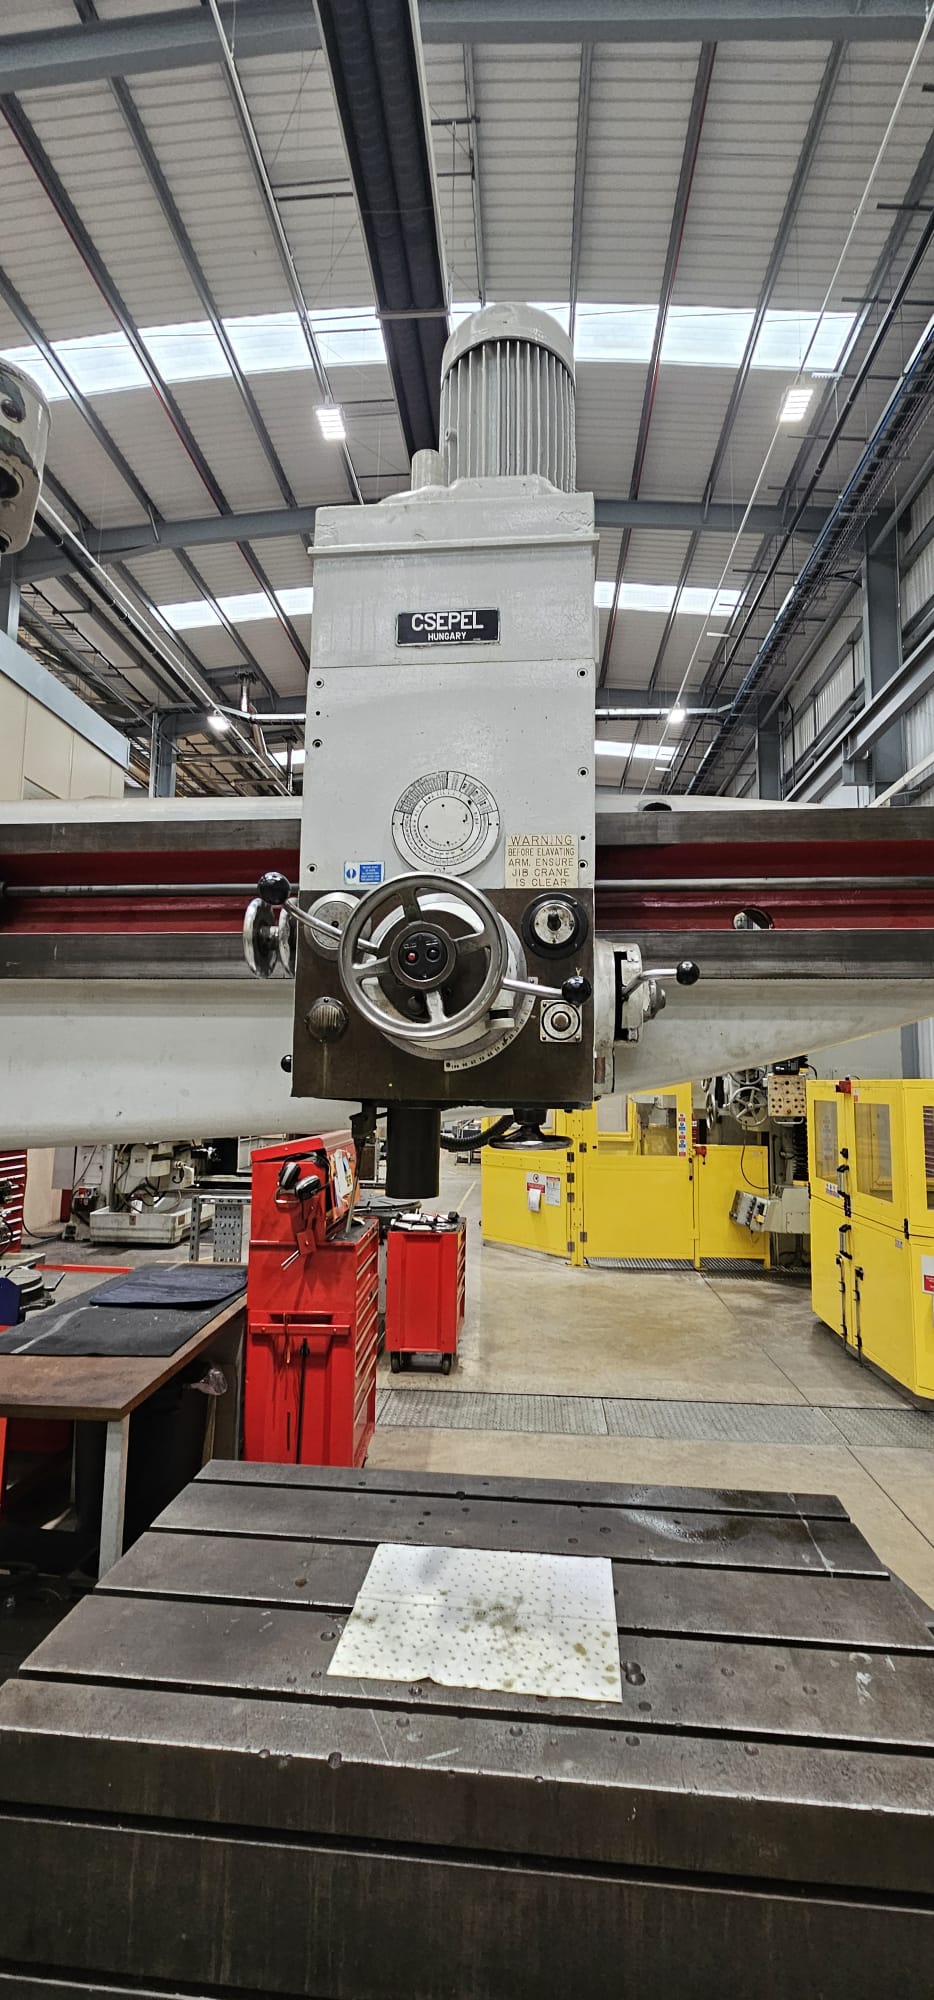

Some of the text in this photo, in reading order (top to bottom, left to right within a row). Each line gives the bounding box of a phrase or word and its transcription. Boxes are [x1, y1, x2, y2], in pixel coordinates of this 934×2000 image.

[411, 611, 484, 631] CSEPEL
[427, 632, 467, 641] HUNGARY
[510, 835, 573, 845] WARNING
[508, 848, 575, 857] BEFORE ELAVATING
[535, 858, 574, 867] ENSURE
[511, 868, 570, 877] JIB CRANE
[515, 878, 567, 887] IS CLEAR
